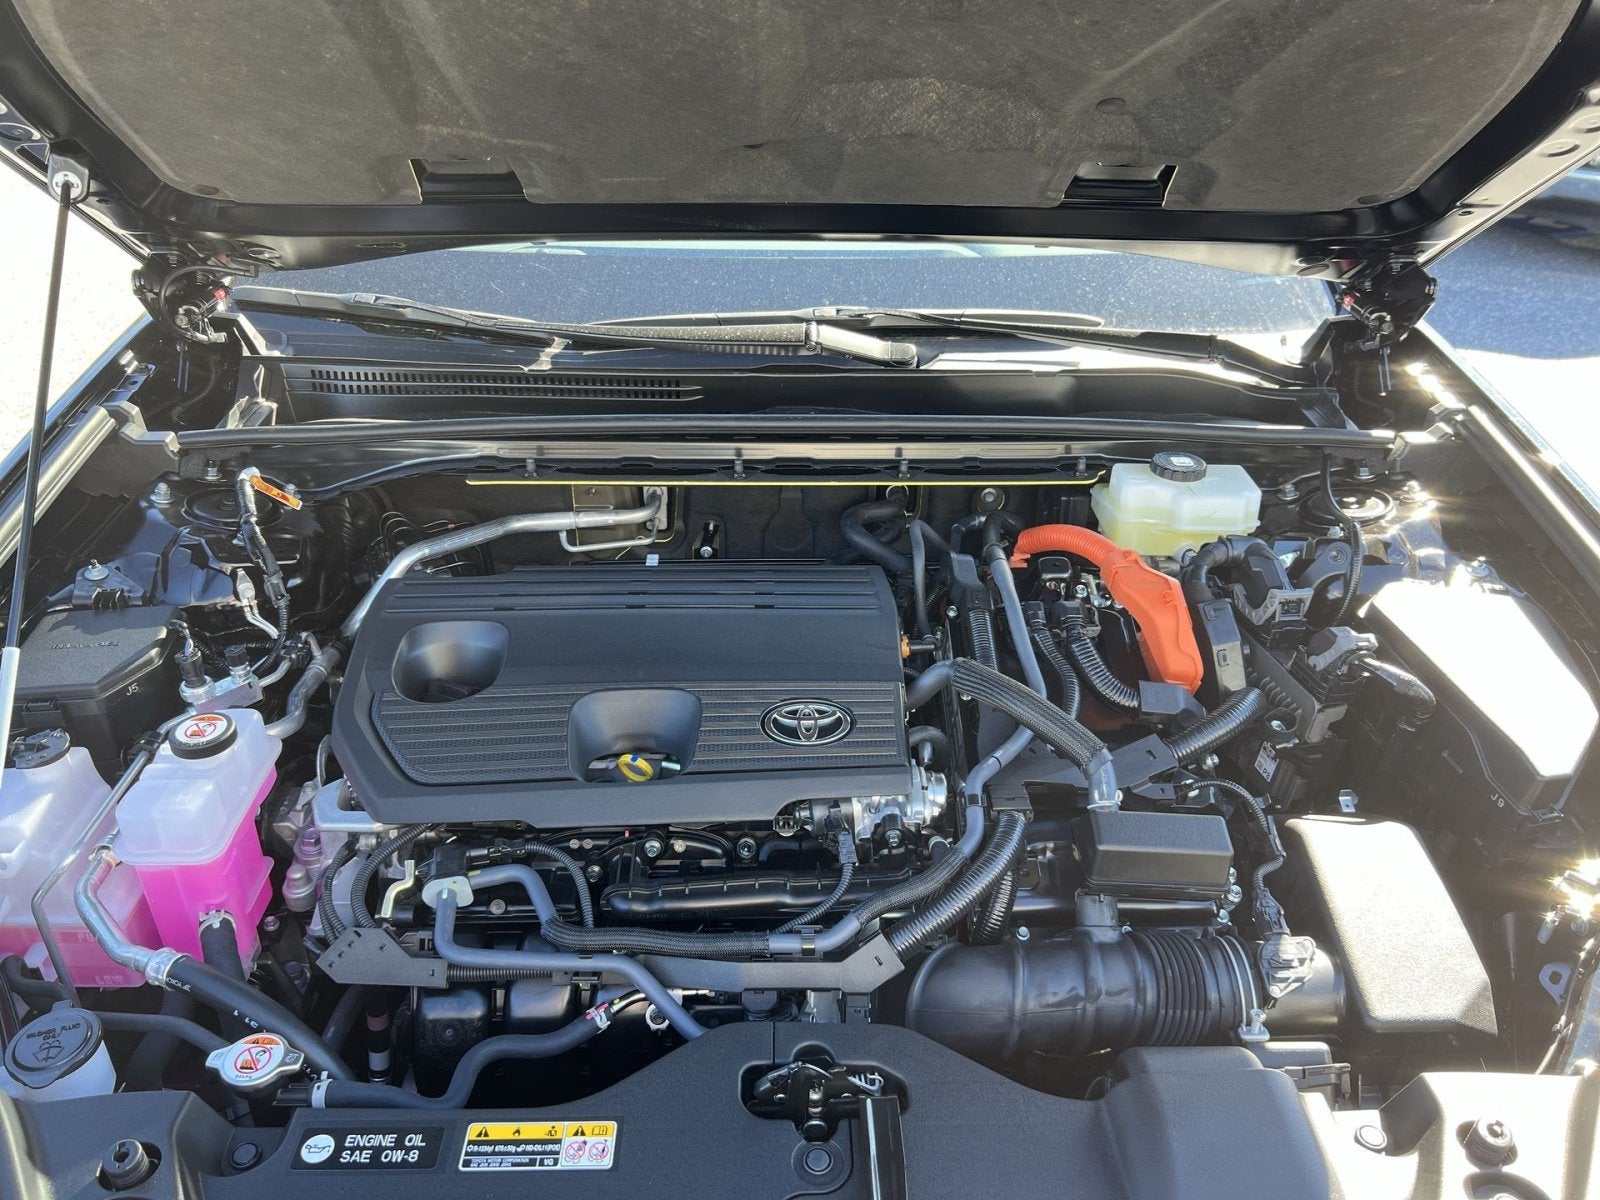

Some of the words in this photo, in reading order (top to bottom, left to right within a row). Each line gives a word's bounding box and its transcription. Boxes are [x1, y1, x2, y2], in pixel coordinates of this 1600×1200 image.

[126, 682, 139, 696] J5
[60, 1023, 81, 1032] FLUID
[344, 1134, 397, 1147] ENGINE
[404, 1134, 426, 1147] OIL
[339, 1149, 373, 1163] SAE
[380, 1149, 419, 1163] 0W-8
